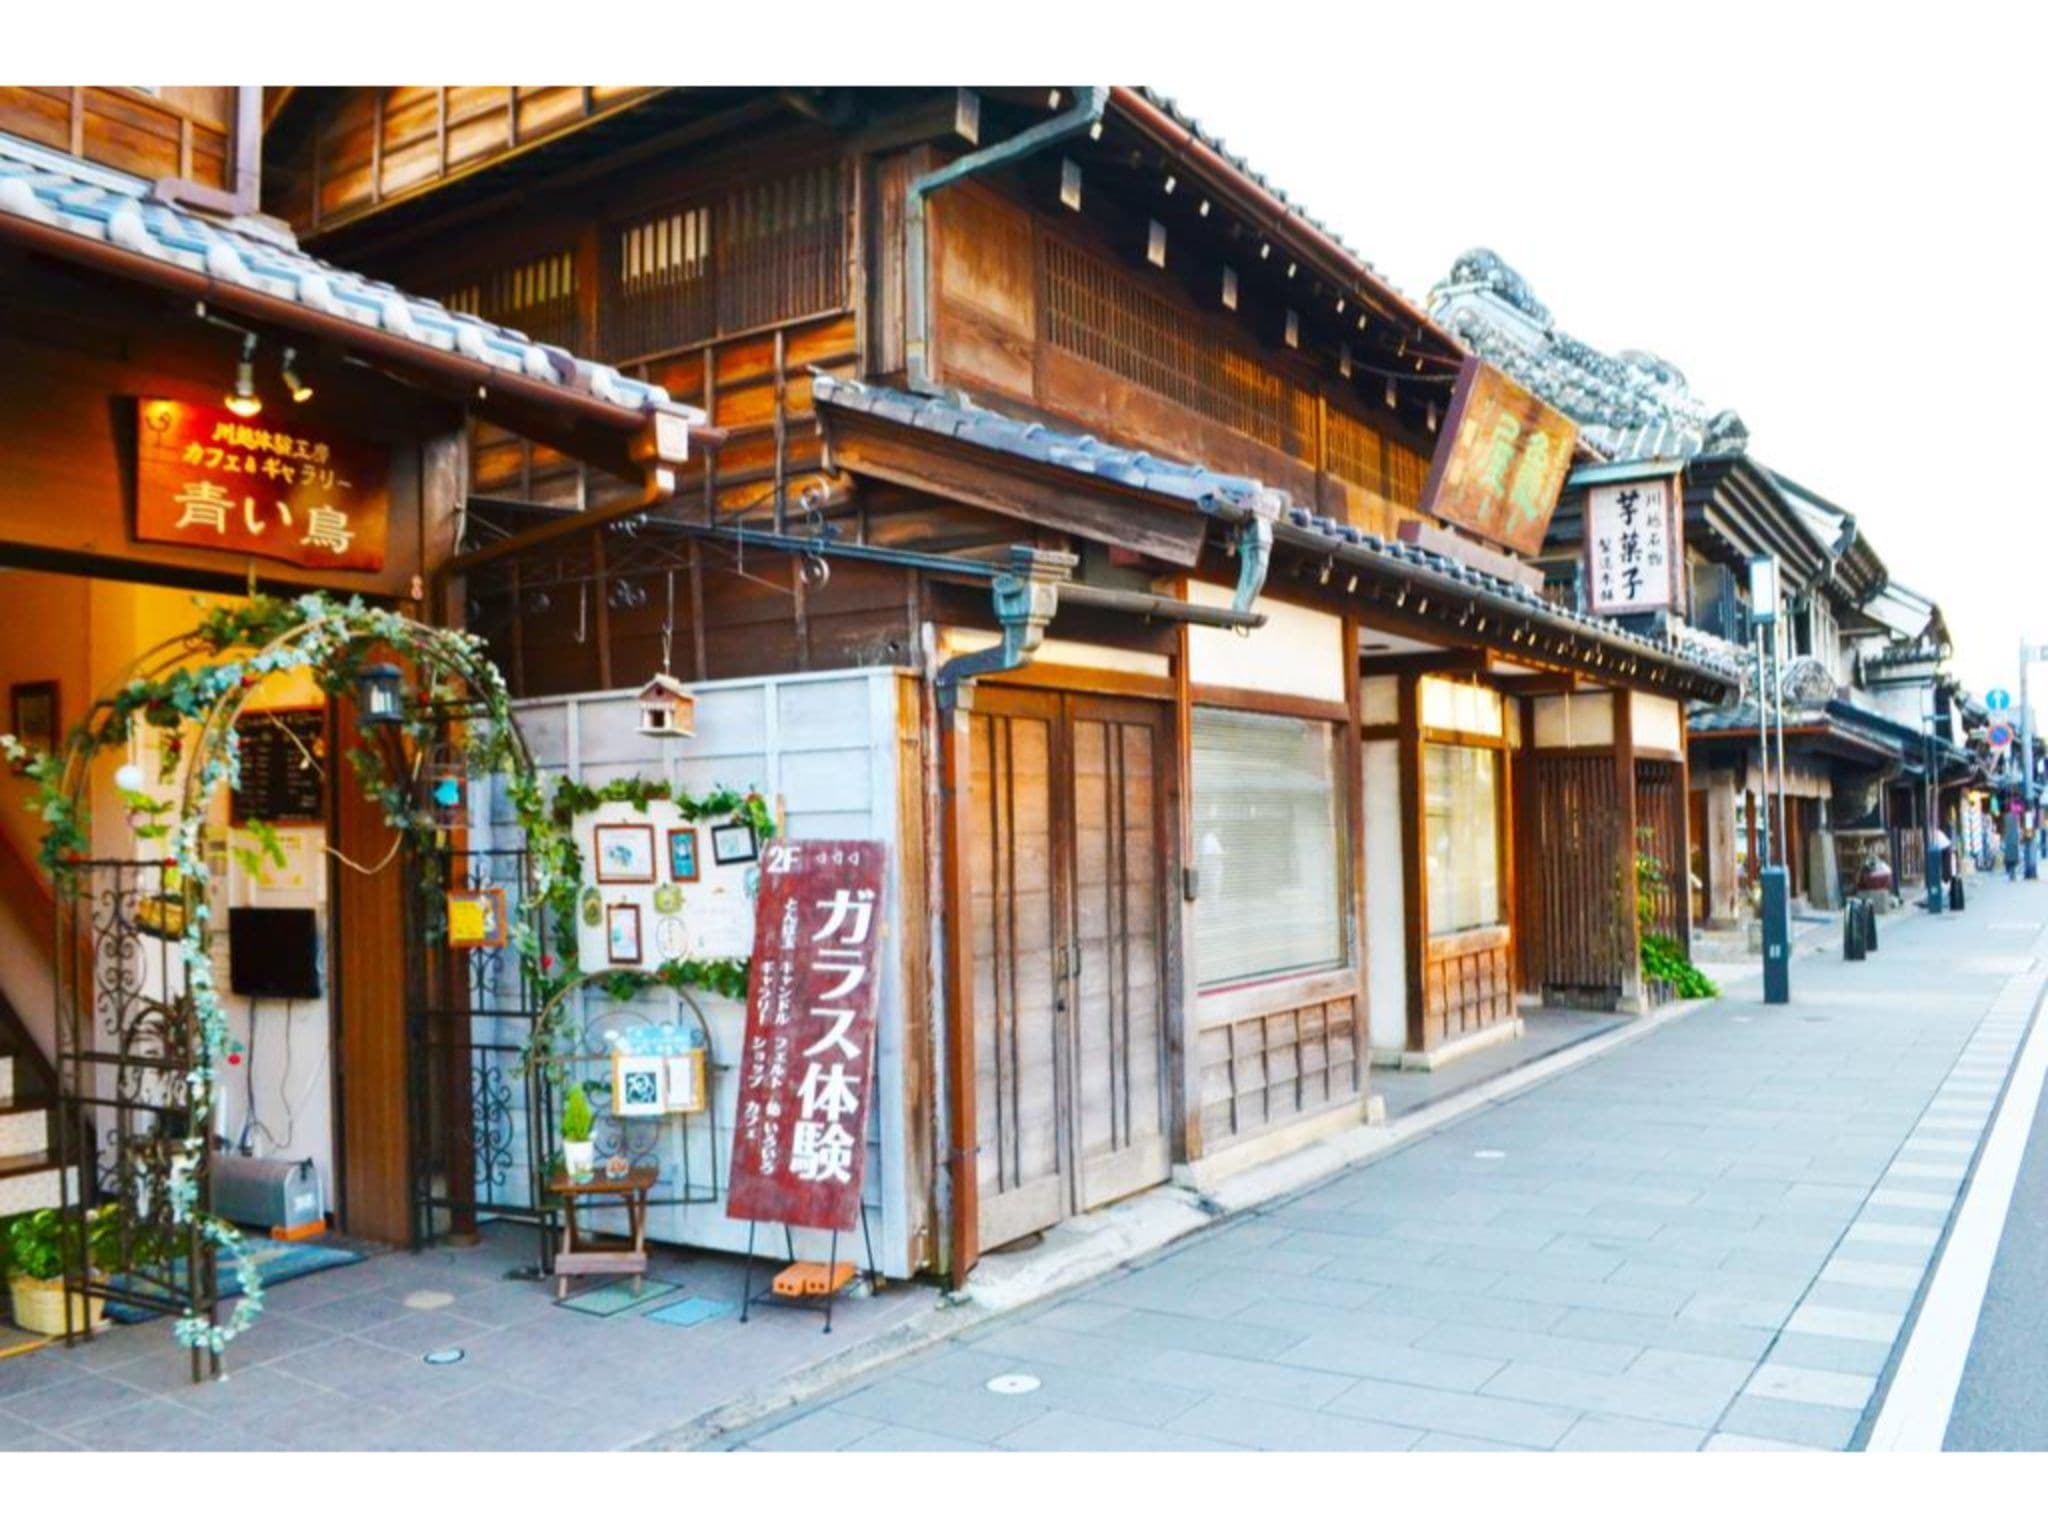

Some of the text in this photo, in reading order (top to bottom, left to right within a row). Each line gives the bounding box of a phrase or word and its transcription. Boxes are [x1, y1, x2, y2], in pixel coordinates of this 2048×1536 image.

[173, 480, 355, 555] 青い鳥
[1616, 488, 1643, 601] 芋菓子
[767, 846, 800, 873] 2F
[748, 1035, 767, 1089] ショップ
[789, 888, 875, 1184] ガラス体験
